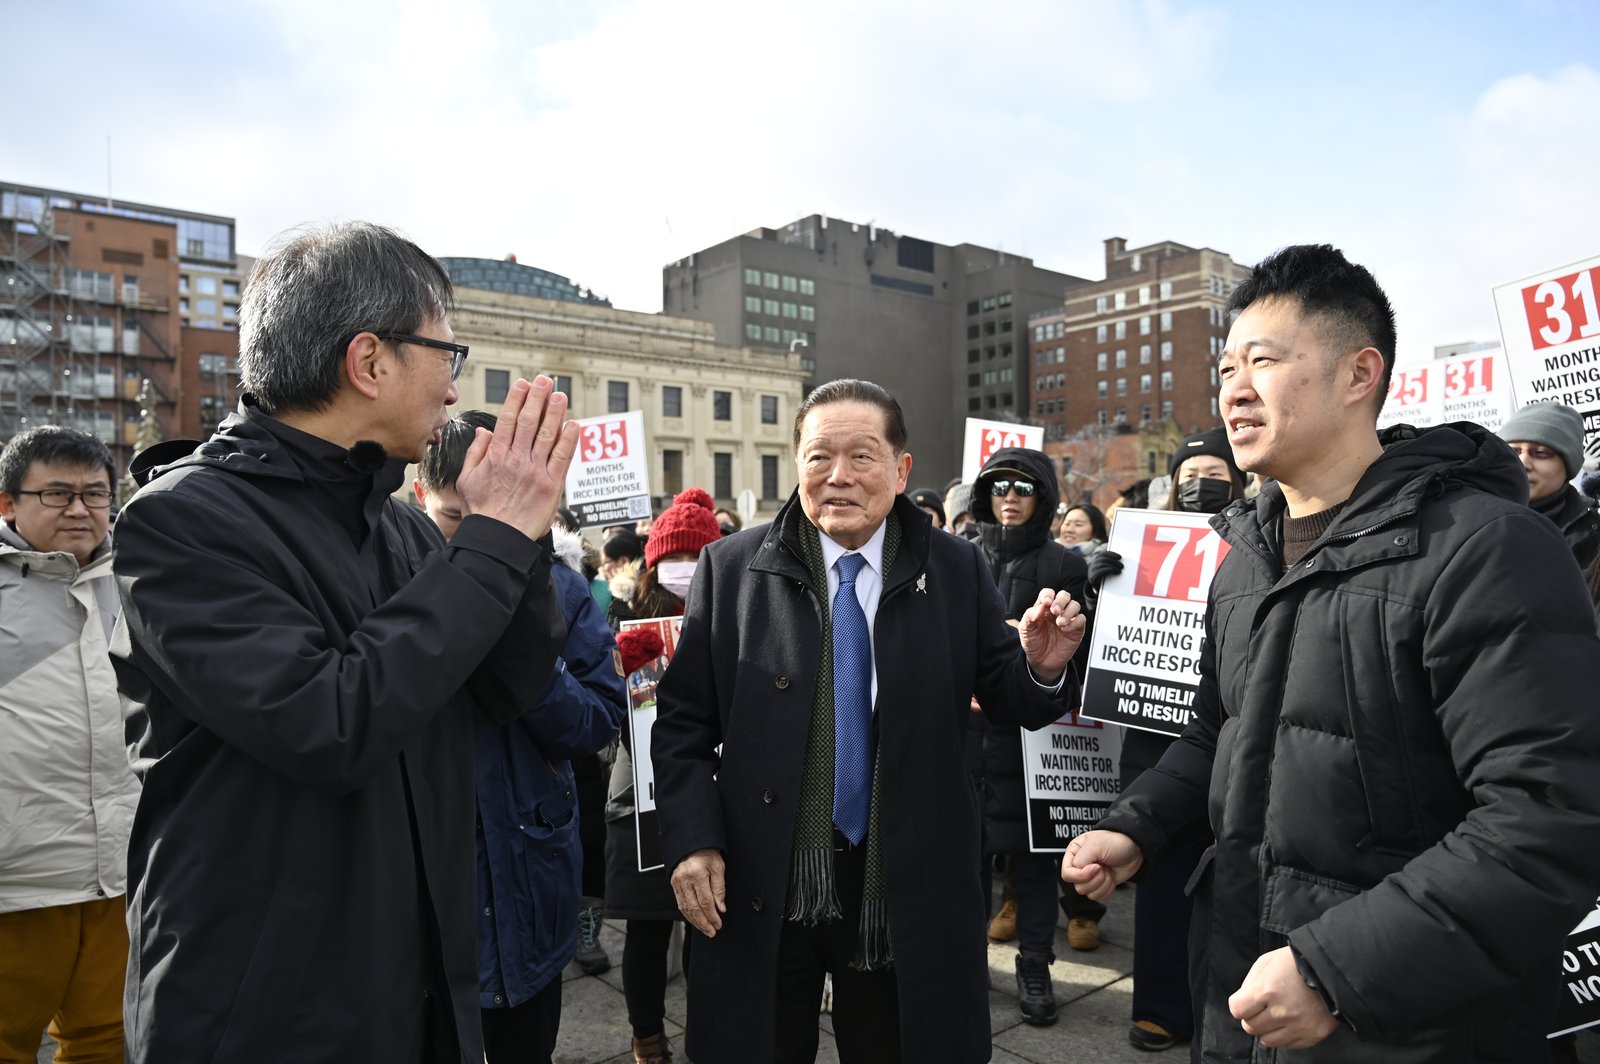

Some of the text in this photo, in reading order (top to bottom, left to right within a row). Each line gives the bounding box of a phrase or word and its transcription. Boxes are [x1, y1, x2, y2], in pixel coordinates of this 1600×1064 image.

[1534, 269, 1600, 346] 31
[1389, 370, 1424, 404] 25
[1446, 359, 1487, 397] 31
[1531, 367, 1600, 393] WAITING
[1445, 399, 1486, 412] MONTHS
[1478, 408, 1498, 418] FOR
[583, 421, 624, 461] 35
[586, 463, 625, 475] MONTHS
[578, 472, 636, 487] WAITING FOR
[573, 482, 641, 499] IRCC RESPONSE
[582, 505, 594, 514] NO
[586, 513, 598, 522] NO
[1153, 526, 1220, 600] 71
[1139, 606, 1205, 630] MONTH
[1117, 624, 1193, 651] WAITING
[1102, 645, 1141, 666] IRCC
[1114, 679, 1136, 695] NO
[1118, 698, 1139, 715] NO
[1052, 733, 1099, 752] MONTHS
[1040, 753, 1113, 773] WAITING FOR
[1035, 774, 1120, 794] IRCC RESPONSE
[1049, 806, 1064, 820] NO
[1055, 824, 1070, 838] NO
[1568, 975, 1600, 1005] NO
